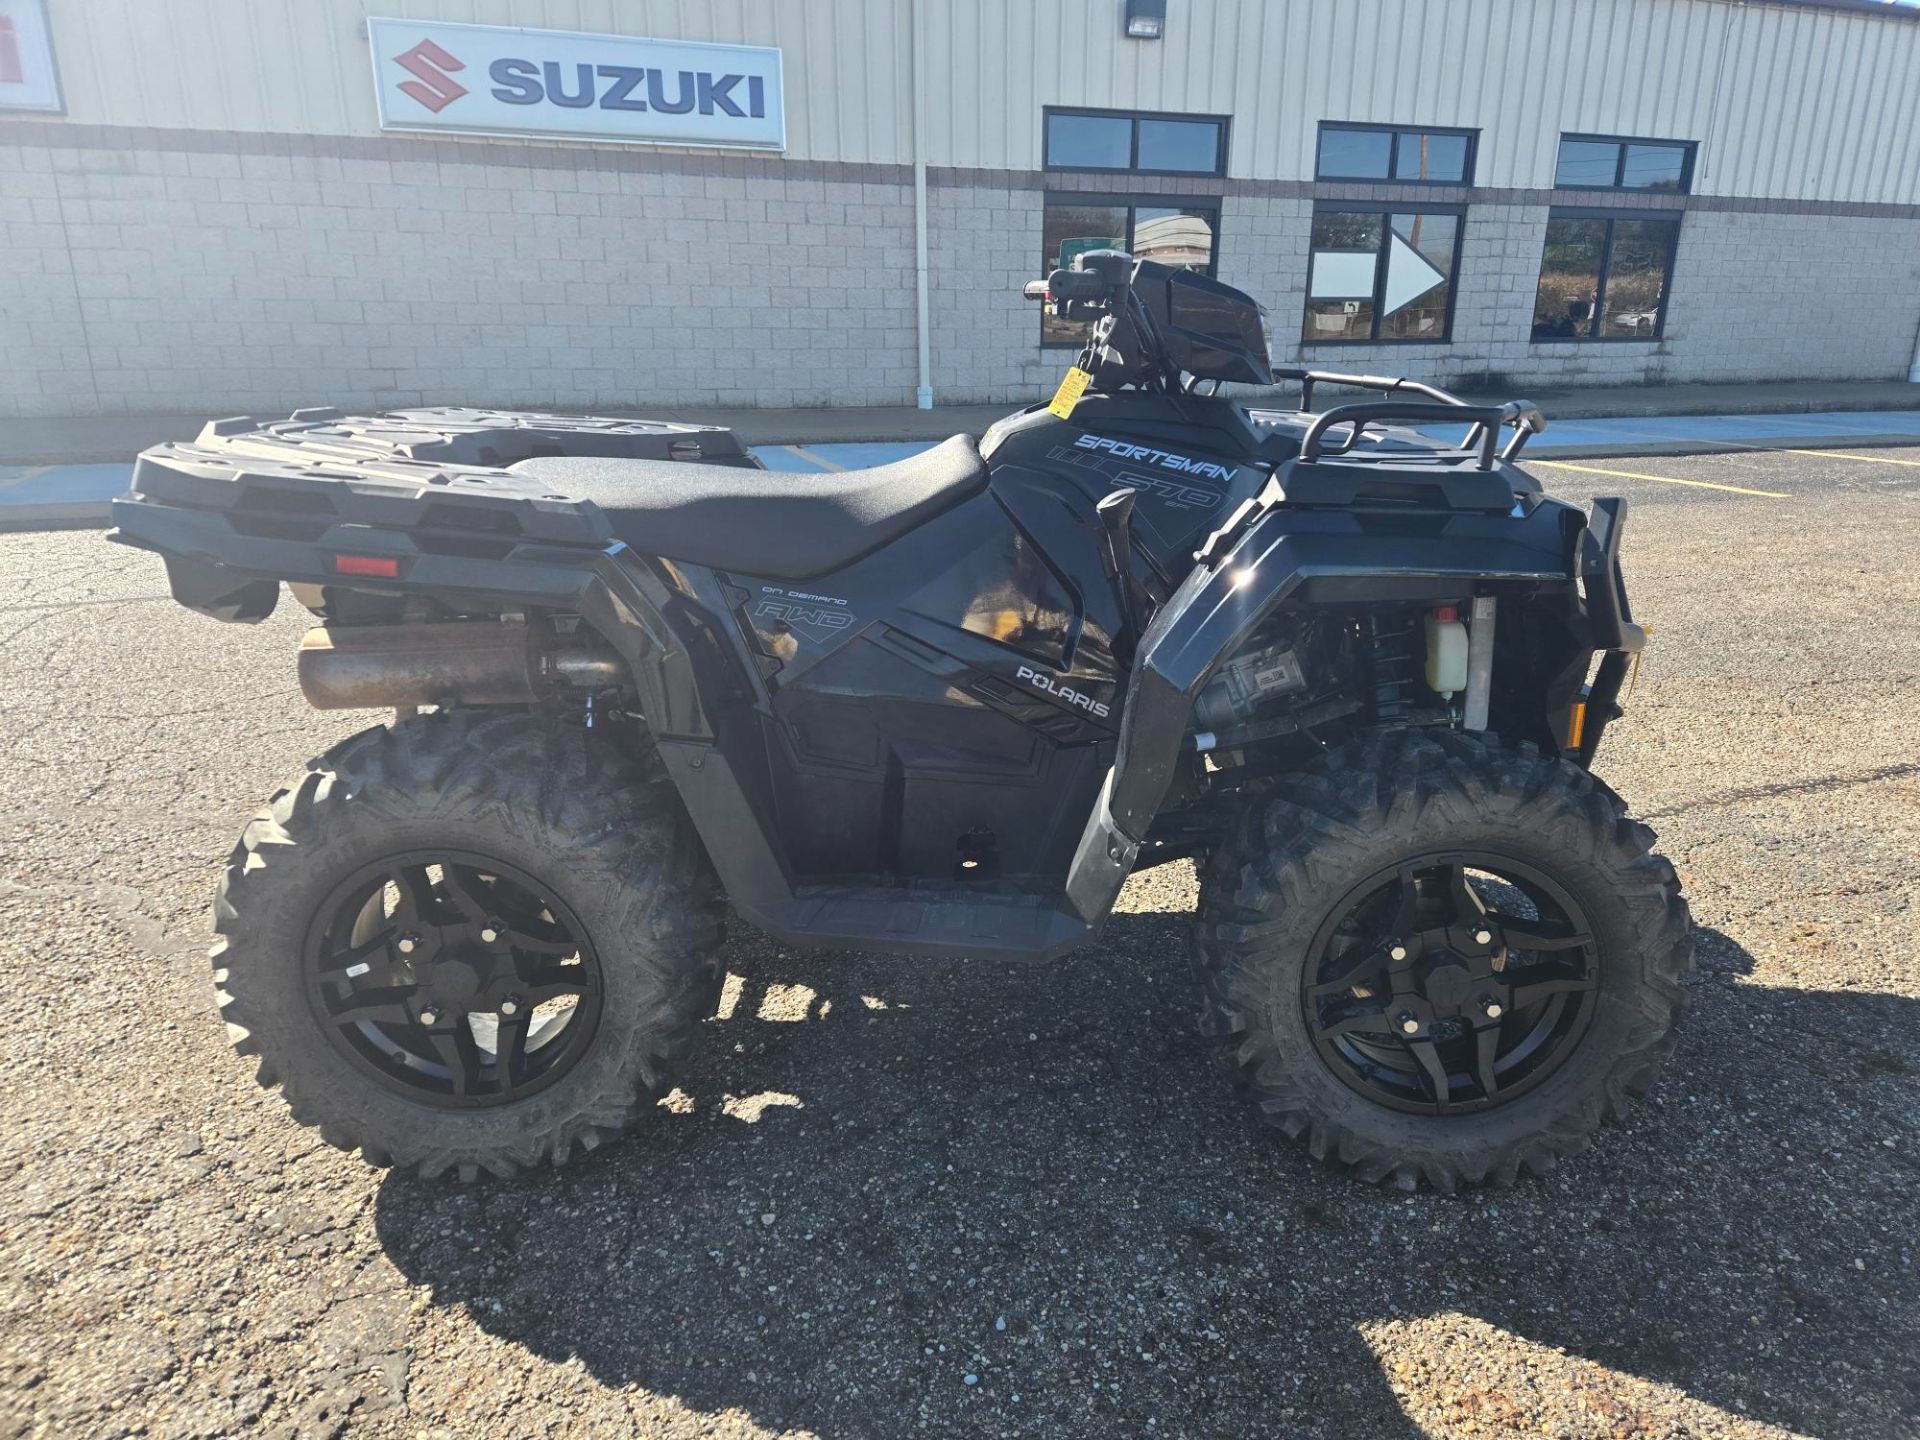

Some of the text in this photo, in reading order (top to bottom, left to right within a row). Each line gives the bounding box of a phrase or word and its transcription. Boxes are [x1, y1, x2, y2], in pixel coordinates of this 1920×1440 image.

[488, 57, 765, 118] SUZUKI
[1074, 434, 1238, 481] SPORTSMAN
[1110, 470, 1221, 508] 570
[754, 601, 853, 630] AWD
[1016, 665, 1110, 718] POLARIS
